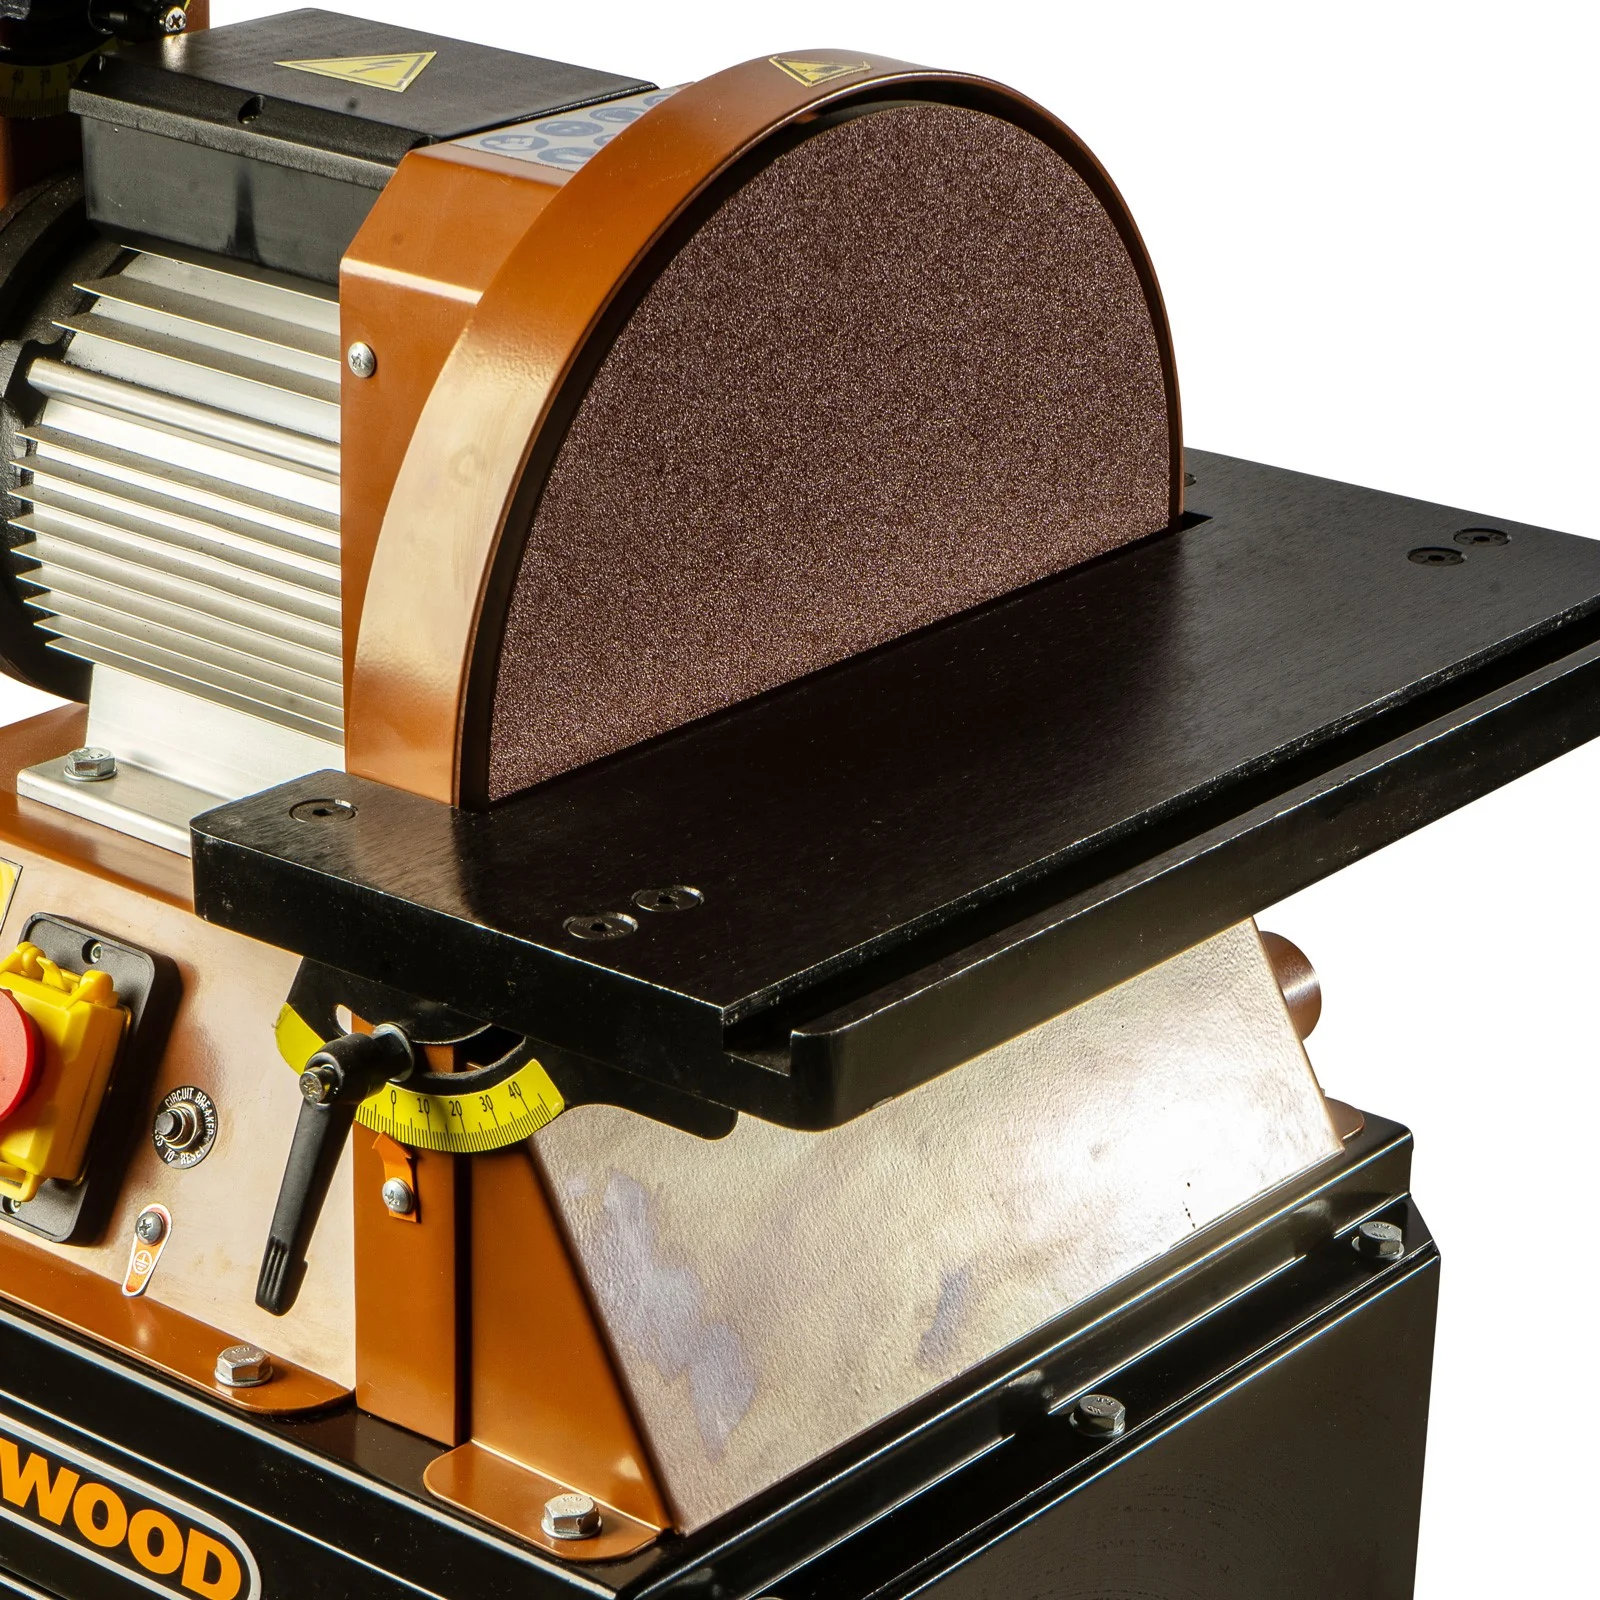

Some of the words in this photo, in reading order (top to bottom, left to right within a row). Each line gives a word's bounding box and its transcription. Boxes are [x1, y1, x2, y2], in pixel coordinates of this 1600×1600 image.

[164, 1087, 194, 1108] CIRCUIT
[194, 1091, 215, 1137] BREAKER
[390, 1089, 397, 1105] 0
[417, 1098, 430, 1114] 10
[449, 1100, 463, 1117] 20
[479, 1094, 494, 1113] 30
[507, 1081, 522, 1099] 40
[164, 1148, 175, 1162] TO
[180, 1146, 205, 1165] RESET
